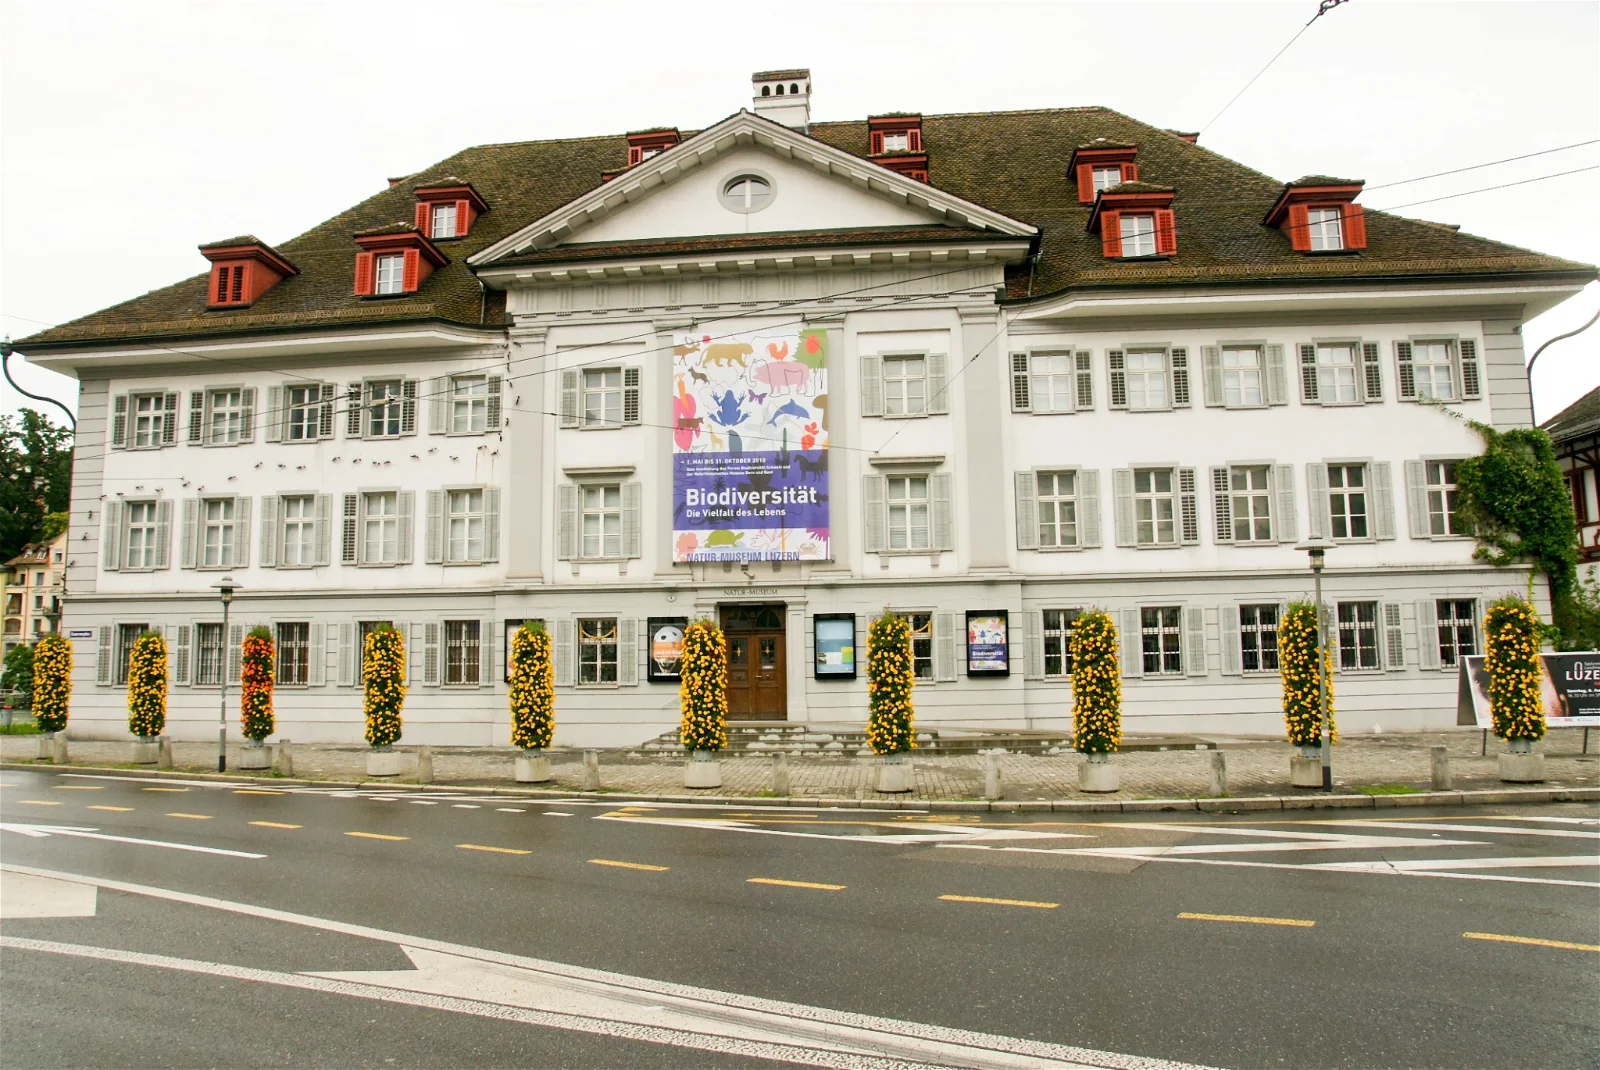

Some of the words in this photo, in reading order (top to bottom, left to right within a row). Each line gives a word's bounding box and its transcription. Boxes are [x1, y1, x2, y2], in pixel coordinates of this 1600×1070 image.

[686, 485, 817, 506] Biodiversität
[686, 509, 700, 517] Die
[702, 508, 735, 517] Vielfalt
[736, 508, 752, 516] des
[753, 508, 786, 516] Lebens
[687, 552, 761, 562] NATUR-MUSEUM
[765, 551, 800, 561] LUZERN
